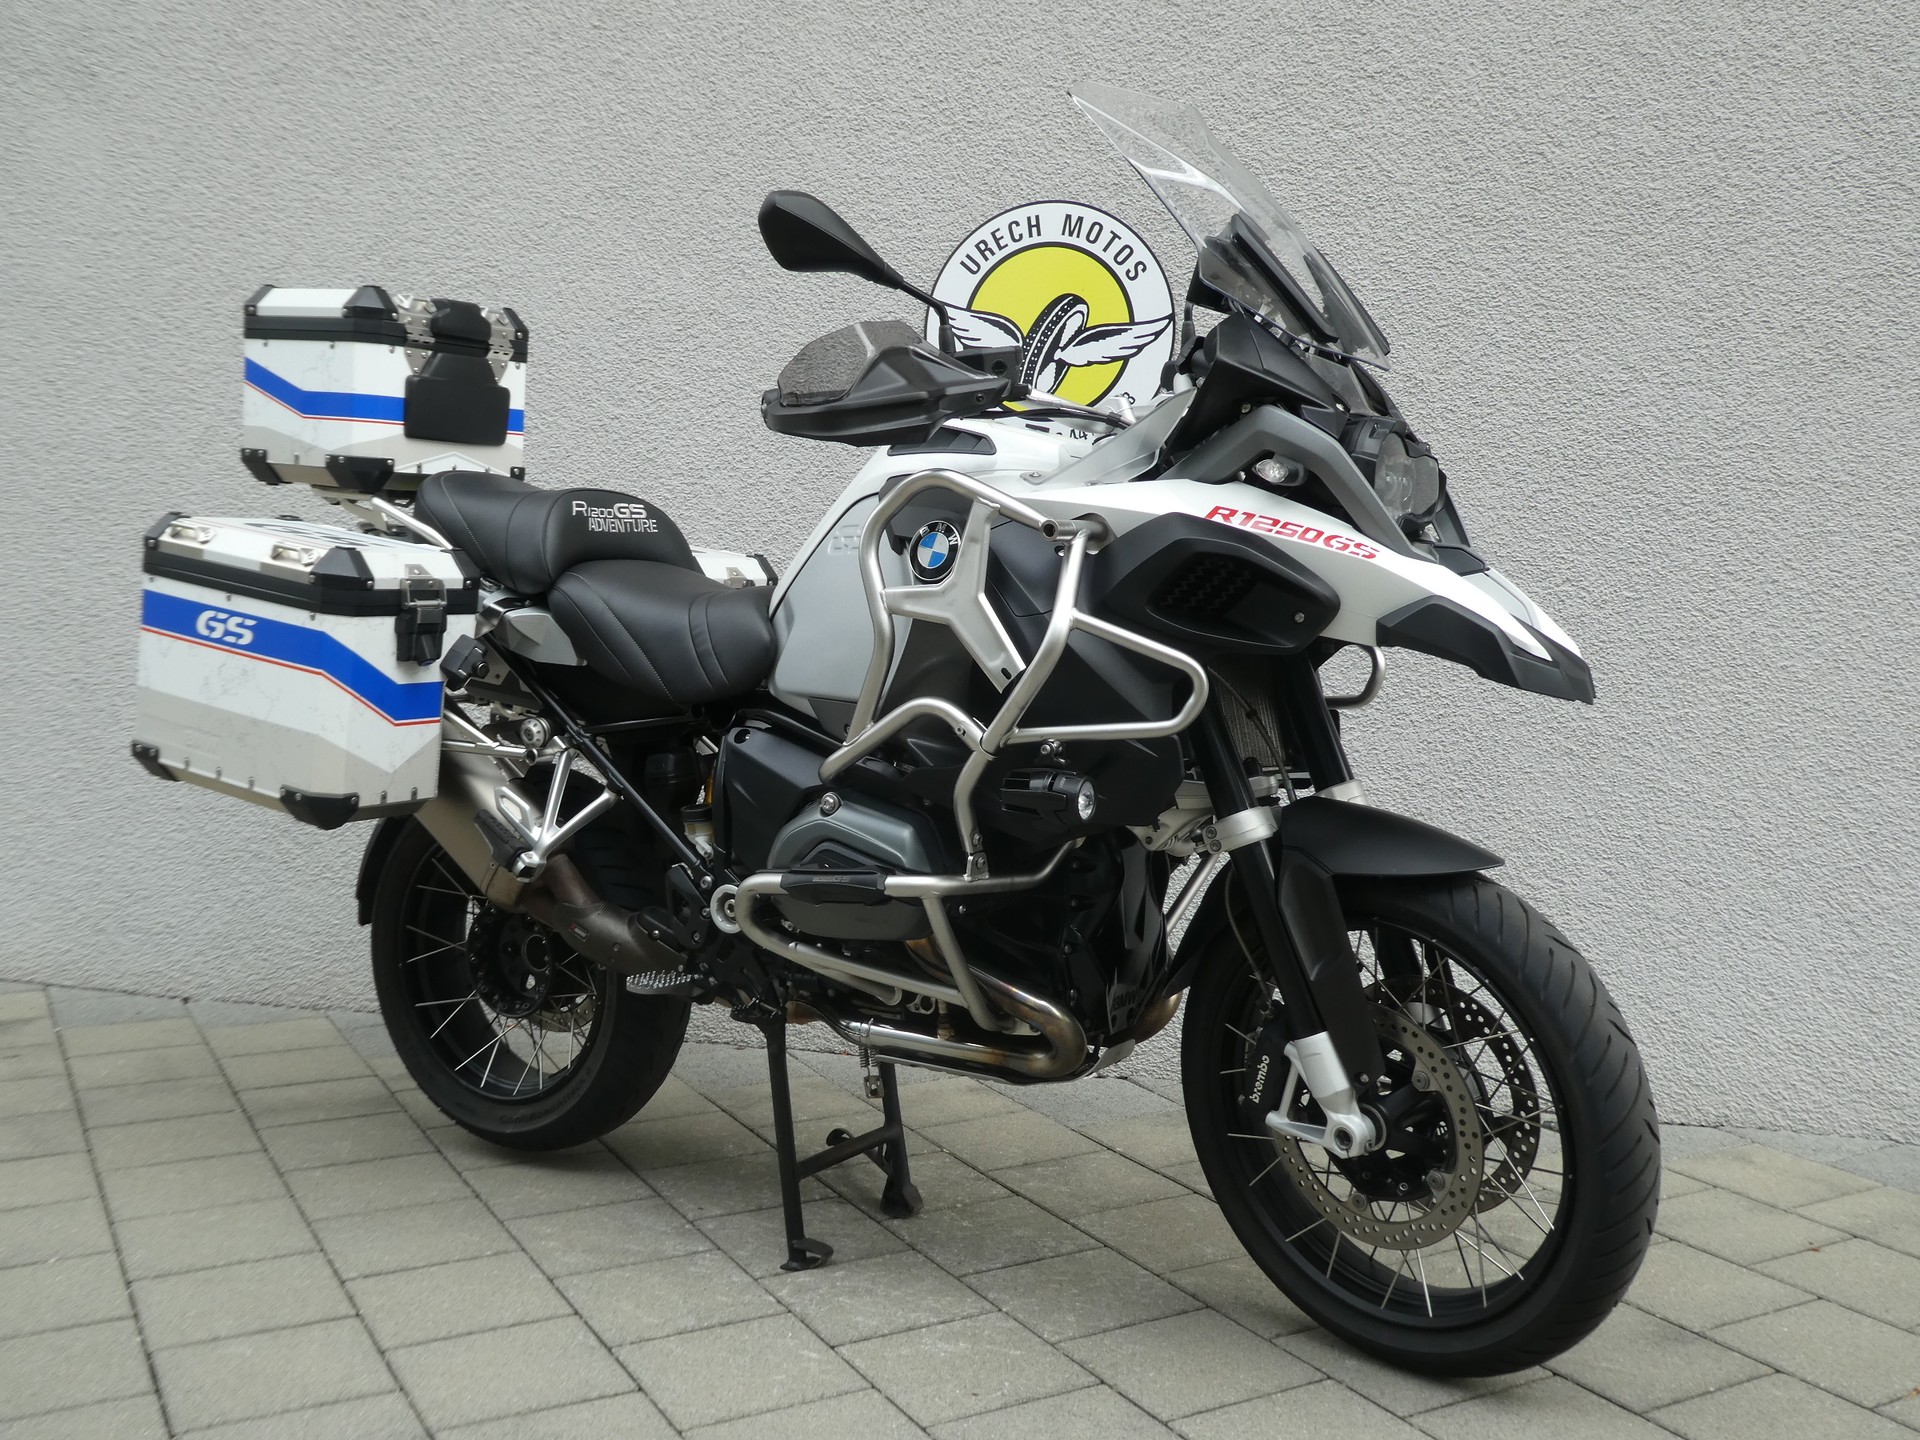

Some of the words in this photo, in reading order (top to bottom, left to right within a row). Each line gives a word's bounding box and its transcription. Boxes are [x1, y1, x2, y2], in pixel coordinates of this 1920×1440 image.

[959, 214, 1042, 276] URECH
[1061, 213, 1148, 282] MOTOS
[572, 500, 648, 519] R1200GS
[588, 518, 659, 533] ADVENTURE
[919, 522, 959, 546] BMW
[1204, 505, 1381, 560] R1250GS
[195, 609, 258, 646] GS
[1249, 1054, 1270, 1104] brembo
